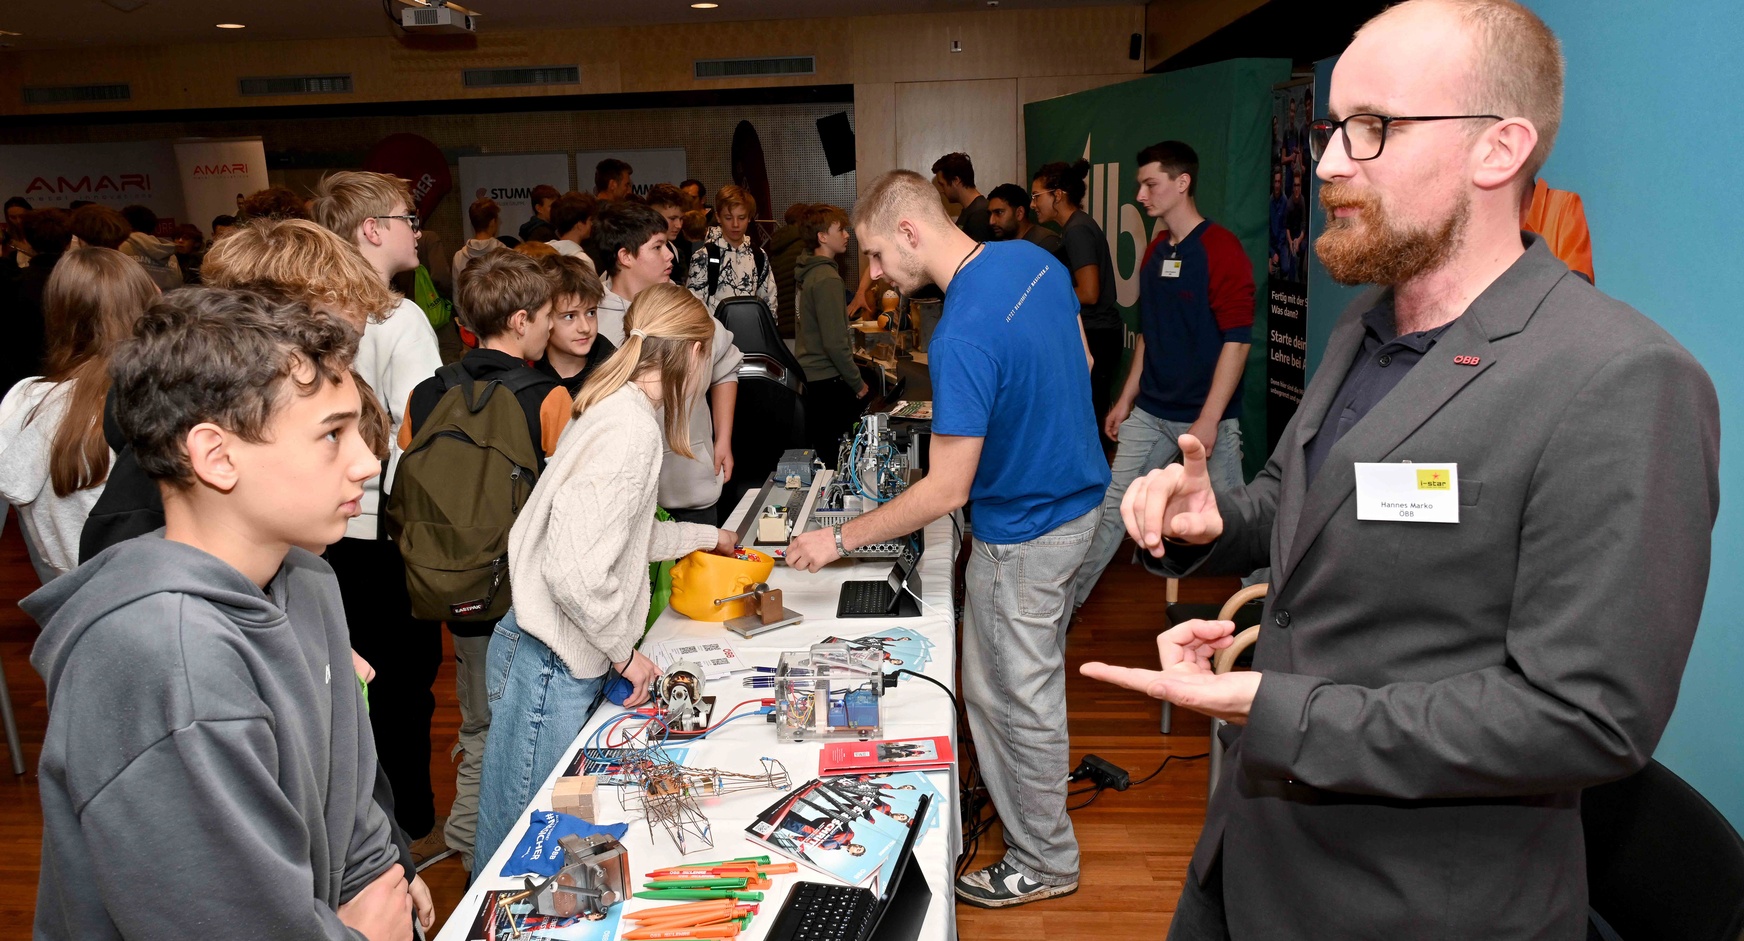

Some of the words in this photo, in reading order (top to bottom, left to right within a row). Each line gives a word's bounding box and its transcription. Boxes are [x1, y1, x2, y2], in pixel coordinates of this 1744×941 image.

[193, 163, 249, 175] AMARI
[25, 174, 151, 194] AMARI
[491, 187, 532, 200] STUMM
[1271, 290, 1287, 304] Fertig
[1287, 294, 1296, 305] mit
[1296, 295, 1304, 306] der
[1271, 304, 1283, 315] Was
[1283, 306, 1299, 319] dann?
[1270, 329, 1293, 347] Starte
[1270, 348, 1291, 365] Lehre
[1291, 353, 1302, 369] bei
[1380, 501, 1408, 509] Hannes
[1410, 502, 1434, 510] Marko
[454, 604, 482, 613] EASTPAK
